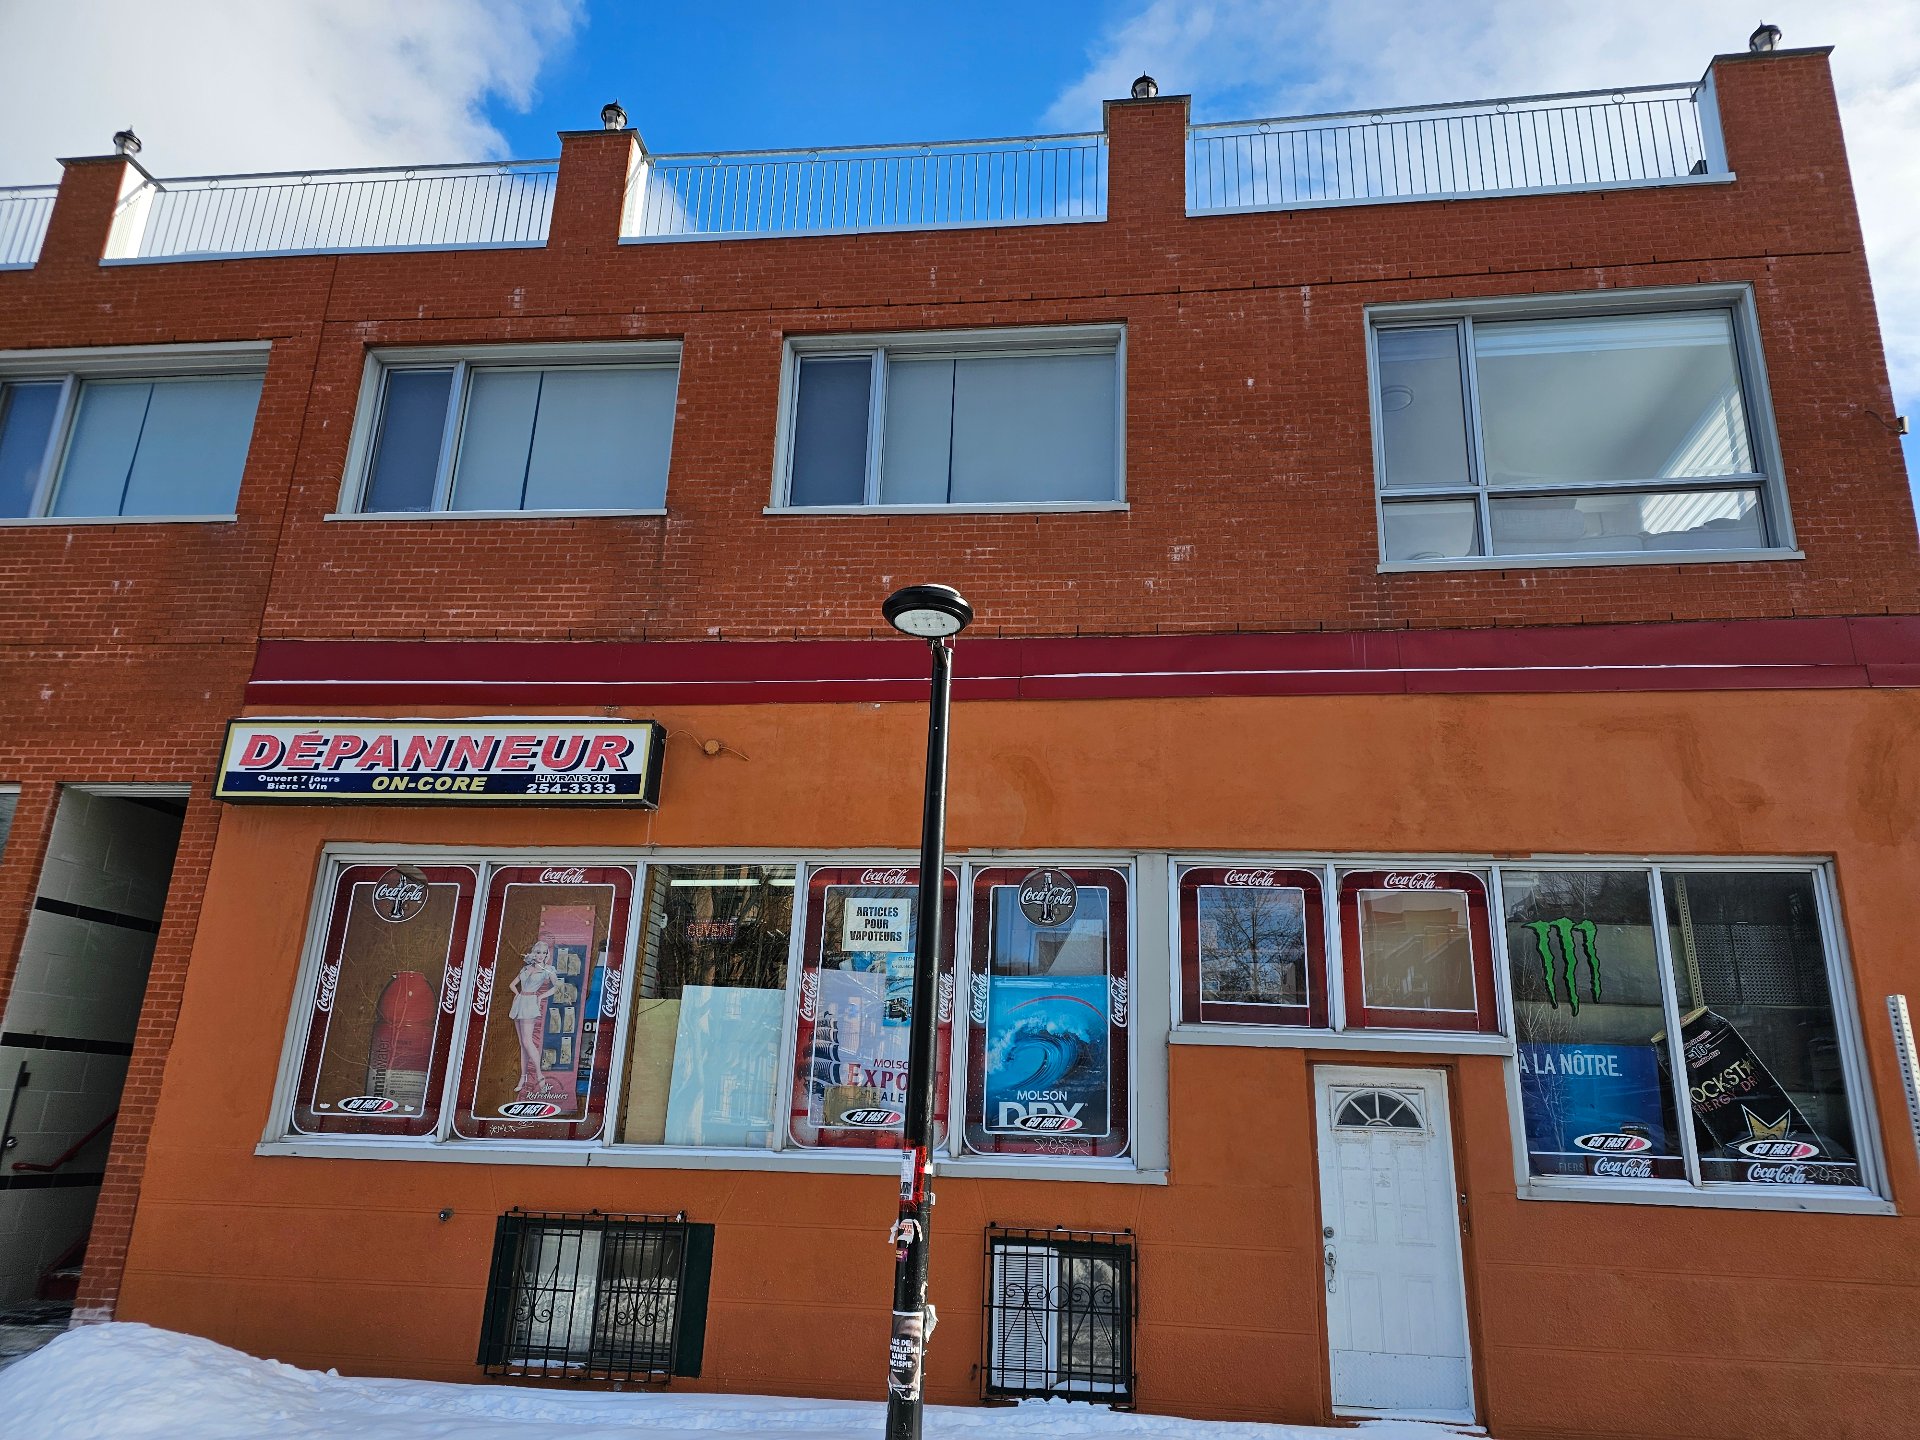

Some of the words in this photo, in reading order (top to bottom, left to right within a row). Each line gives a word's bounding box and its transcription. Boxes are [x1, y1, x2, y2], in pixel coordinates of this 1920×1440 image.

[239, 729, 635, 772] DÉPANNEUR
[257, 774, 297, 782] Ouvert
[300, 774, 307, 782] 7
[309, 774, 340, 783] jours
[267, 781, 298, 790] Bière
[308, 782, 327, 790] Vin
[372, 776, 488, 791] ON-CORE
[535, 774, 610, 783] LIVRAISON
[526, 783, 616, 794] 254-3333
[540, 868, 587, 884] Coca-Cola
[861, 869, 910, 884] Coca-Cola
[1224, 869, 1276, 886] Coca-Cola
[1384, 872, 1438, 889] Coca-Cola
[375, 883, 425, 901] Coca-Cola
[1021, 886, 1073, 905] Coca-Cola
[856, 906, 899, 917] ARTICLES
[687, 922, 736, 937] OUVERT
[864, 918, 889, 929] POUR
[850, 930, 902, 942] VAPOTEURS
[317, 962, 338, 1012] Coca-Cola
[442, 964, 462, 1014] Coca-Cola
[473, 964, 493, 1016] Coca-Cola
[602, 966, 622, 1018] Coca-Cola
[800, 969, 818, 1022] Coca-Cola
[970, 970, 988, 1024] Coca-Cola
[1111, 974, 1128, 1028] Coca-Cola
[873, 1058, 909, 1069] MOLSO
[1519, 1049, 1530, 1074] À
[1533, 1053, 1556, 1075] LA
[1560, 1049, 1623, 1077] NÔTRE.
[543, 1082, 554, 1092] Air
[881, 1092, 904, 1104] ALE
[1017, 1090, 1068, 1101] MOLSON
[1694, 1088, 1737, 1114] NERGY
[852, 1111, 865, 1122] GO
[1026, 1117, 1042, 1128] GO
[1587, 1136, 1603, 1147] GO
[1753, 1143, 1768, 1155] GO
[1559, 1162, 1585, 1173] FIERS
[1594, 1156, 1653, 1178] Coca-Cola
[1747, 1162, 1808, 1184] Coca-Cola
